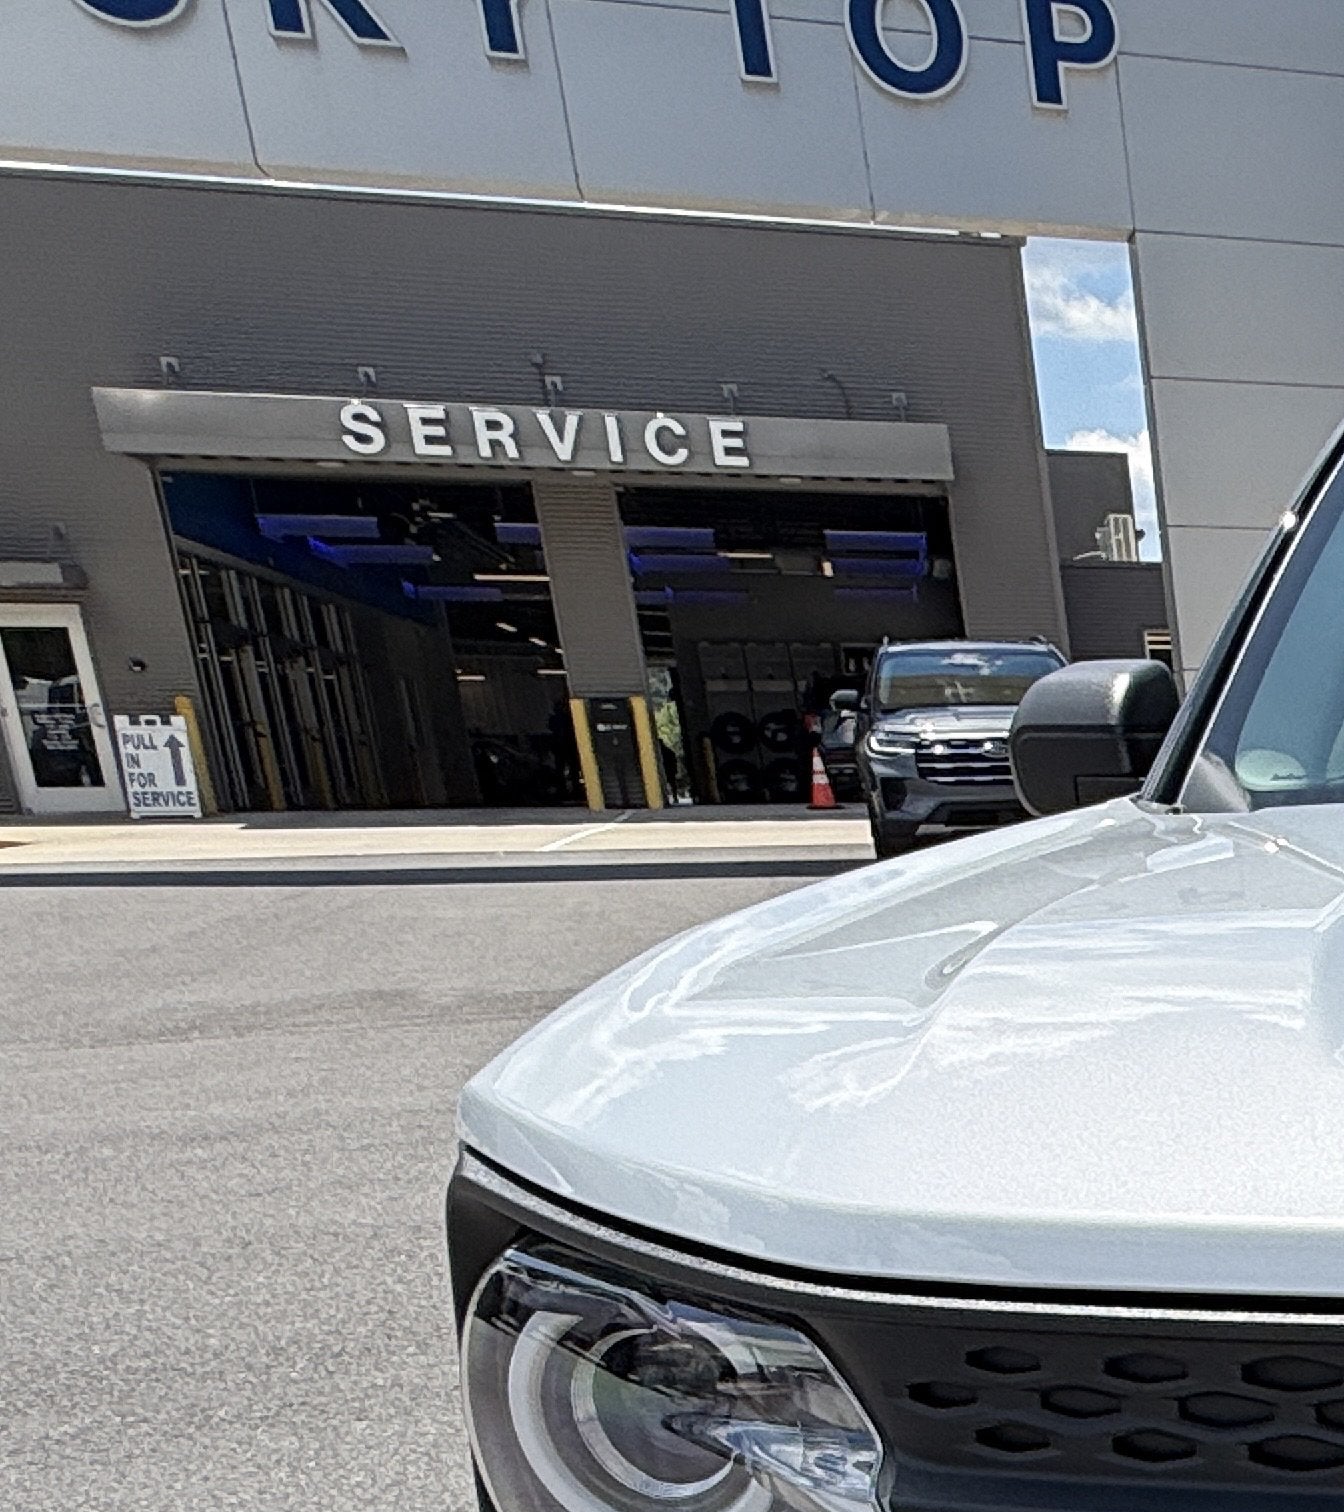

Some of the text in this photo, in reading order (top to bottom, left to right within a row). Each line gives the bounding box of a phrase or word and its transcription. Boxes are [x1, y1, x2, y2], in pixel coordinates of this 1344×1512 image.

[340, 403, 750, 468] SERVICE
[121, 733, 158, 751] PULL
[125, 752, 141, 769] IN
[128, 772, 157, 789] FOR
[132, 791, 197, 807] SERVICE
